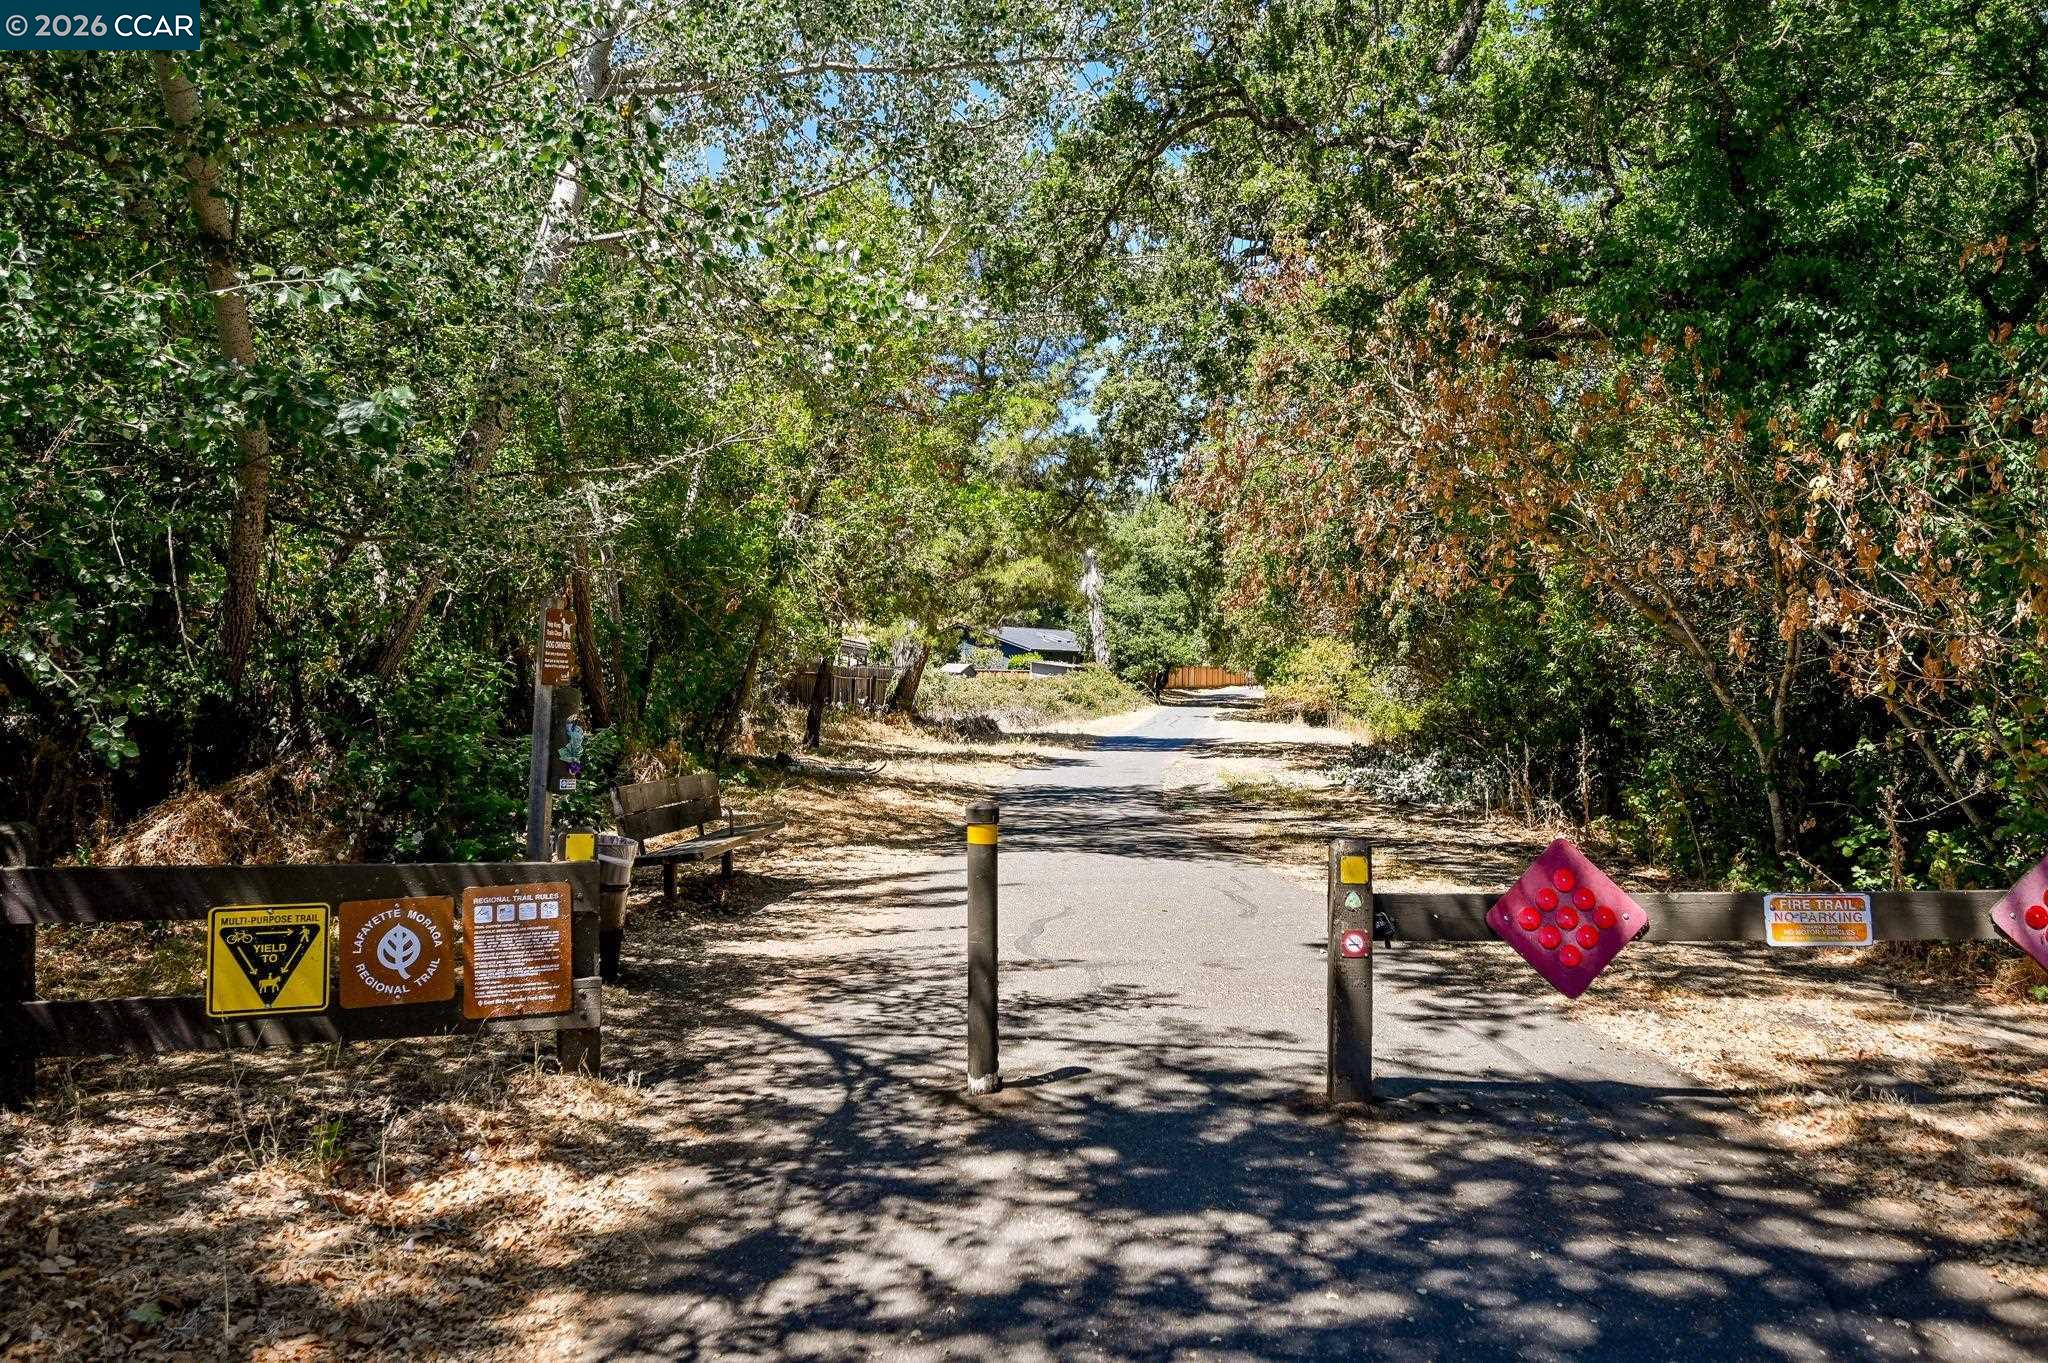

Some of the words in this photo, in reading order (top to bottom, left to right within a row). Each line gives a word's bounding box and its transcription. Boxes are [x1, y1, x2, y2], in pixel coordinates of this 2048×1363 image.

[1780, 900, 1810, 910] FIRE
[1815, 900, 1856, 910] TRAIL
[221, 915, 292, 926] MULTI-PURPOSE
[295, 914, 320, 922] TRAIL
[1774, 912, 1793, 922] NO
[1800, 912, 1863, 922] PARKING
[353, 909, 401, 954] LAFAYETTE
[407, 910, 443, 948] MORAGA
[253, 943, 287, 953] YIELD
[260, 954, 278, 963] TO
[355, 963, 411, 994] REGIONAL
[414, 958, 440, 987] TRAIL
